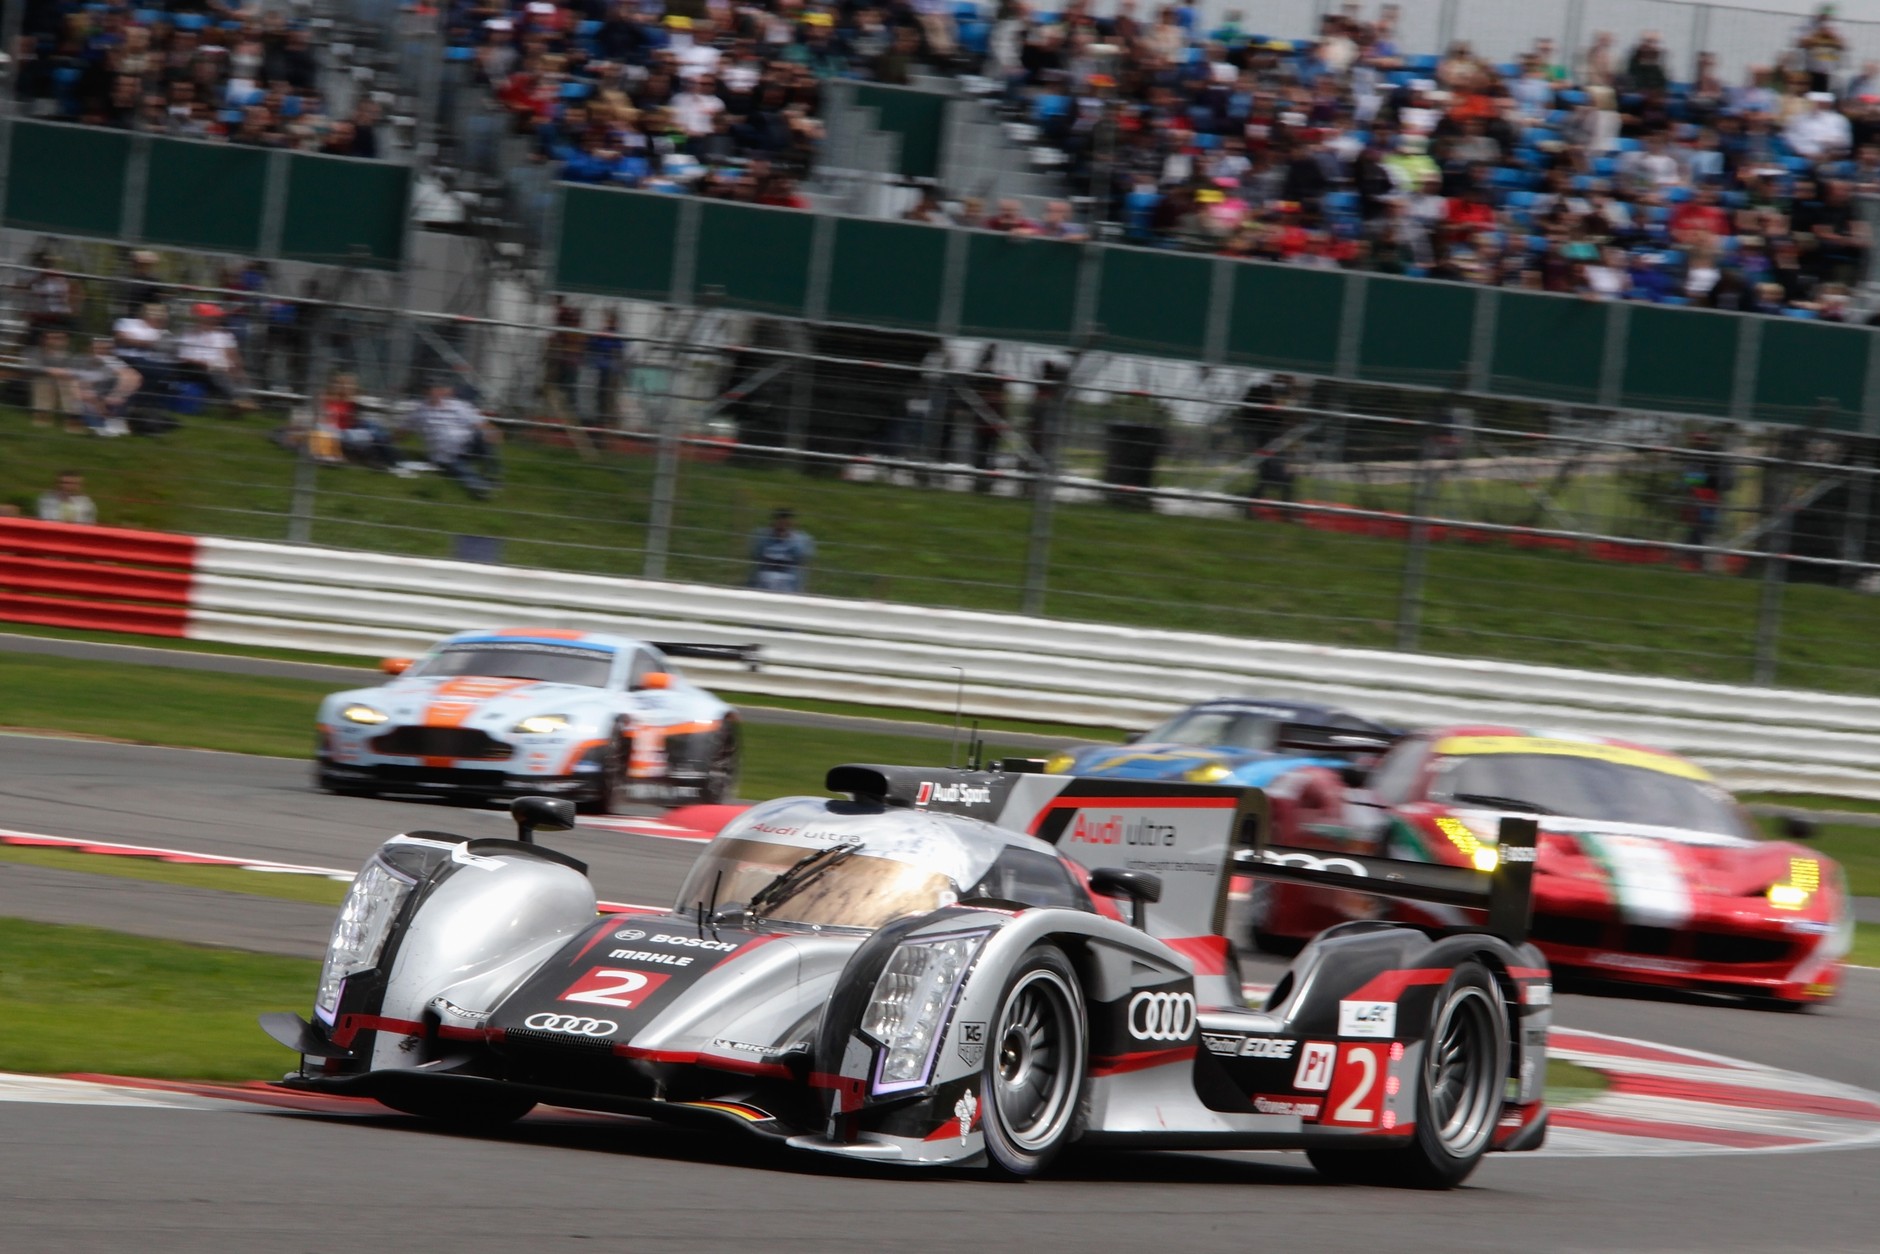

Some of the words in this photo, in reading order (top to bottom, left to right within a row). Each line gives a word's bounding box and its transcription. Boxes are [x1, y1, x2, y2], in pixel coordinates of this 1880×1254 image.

[932, 782, 959, 802] Audi
[960, 783, 990, 807] Sport
[752, 822, 800, 836] Audi
[803, 831, 862, 844] ultra
[1071, 813, 1124, 845] Audi
[1126, 816, 1177, 847] ultra
[649, 933, 738, 952] BOSCH
[608, 949, 694, 967] MAHLE
[565, 970, 648, 1008] 2
[964, 1025, 982, 1042] TAG
[1239, 1037, 1298, 1059] EDGE
[1303, 1050, 1328, 1083] P1
[1333, 1047, 1378, 1123] 2
